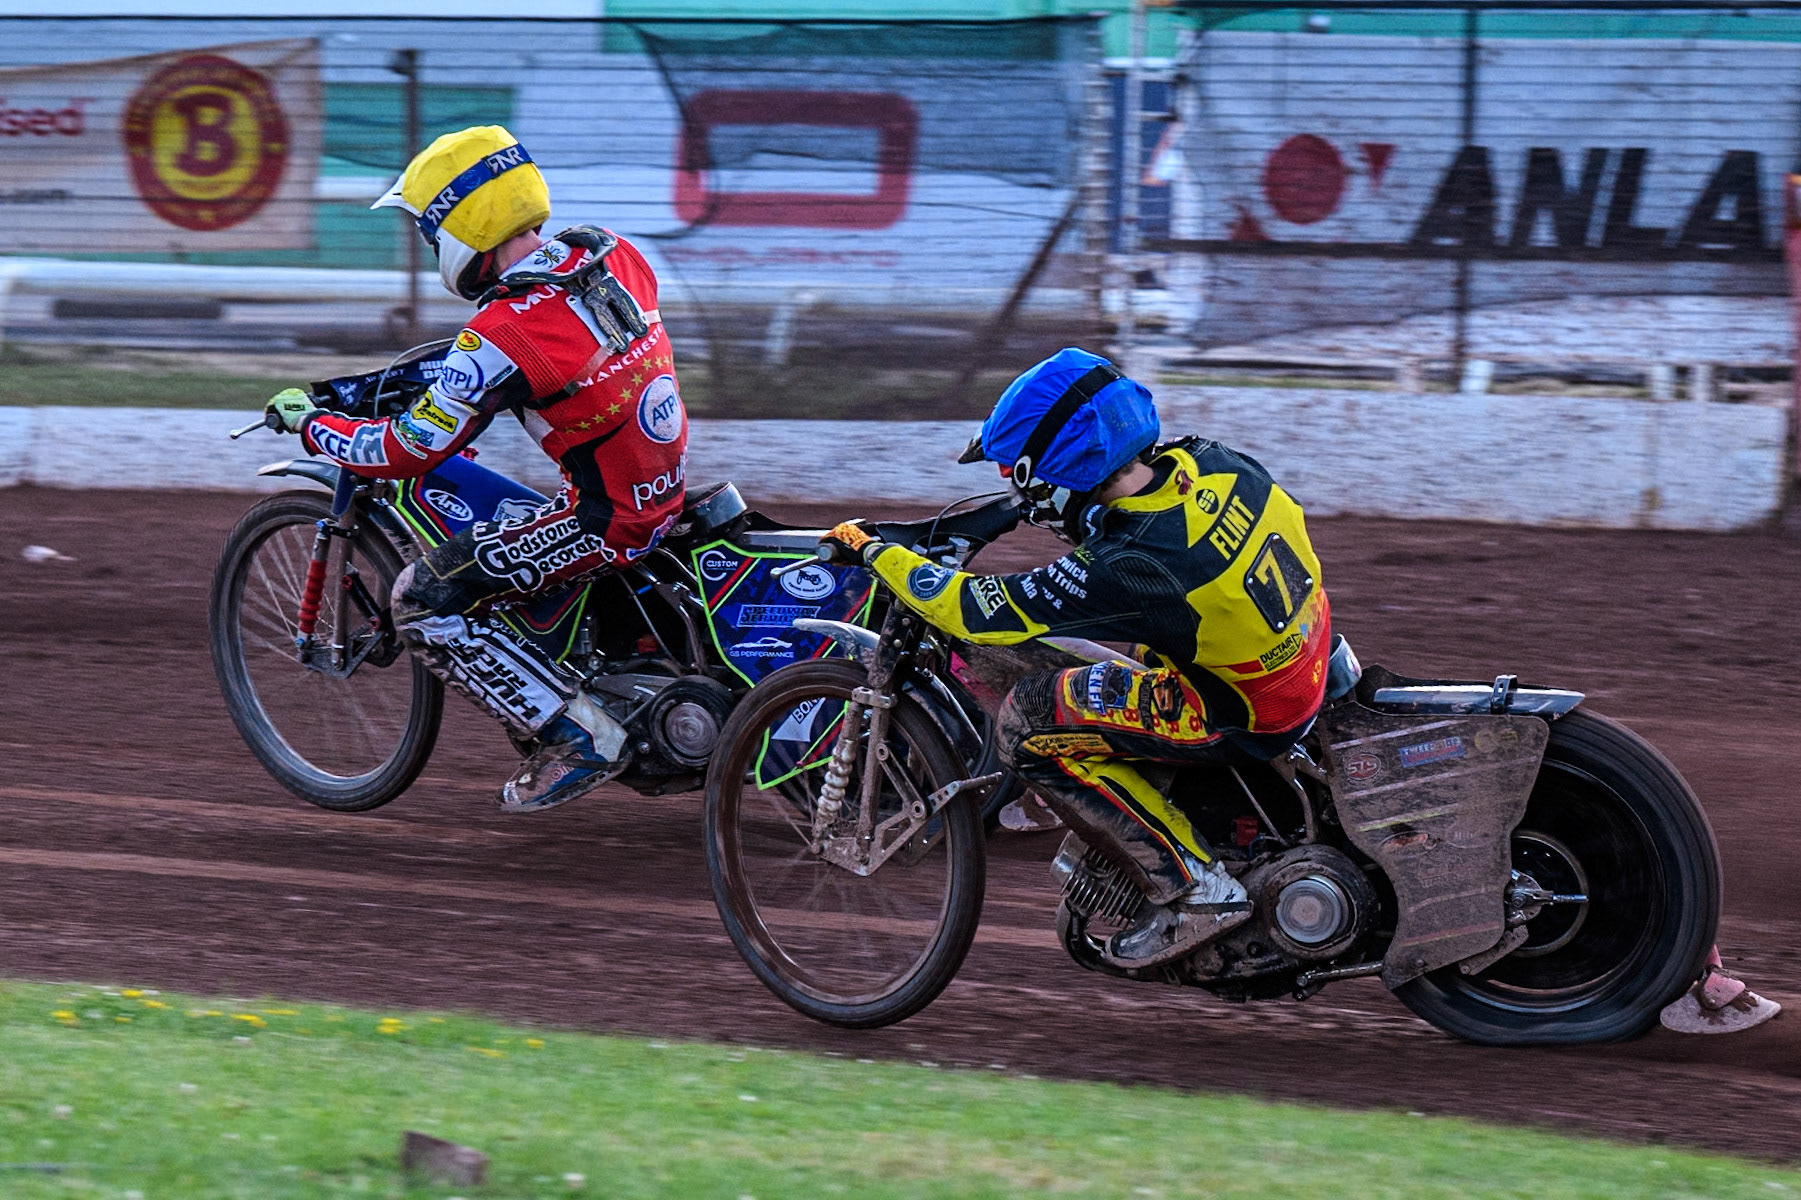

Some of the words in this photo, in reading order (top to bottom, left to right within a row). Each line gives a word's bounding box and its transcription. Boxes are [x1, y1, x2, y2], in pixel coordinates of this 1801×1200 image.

[1209, 494, 1256, 561] FLINT
[474, 515, 580, 578] Godstone
[706, 560, 738, 568] CUSTOM
[1055, 571, 1087, 599] Trips
[1255, 547, 1293, 617] 7
[741, 650, 795, 658] PERFORMANCE
[1260, 636, 1294, 664] DUCTAIR
